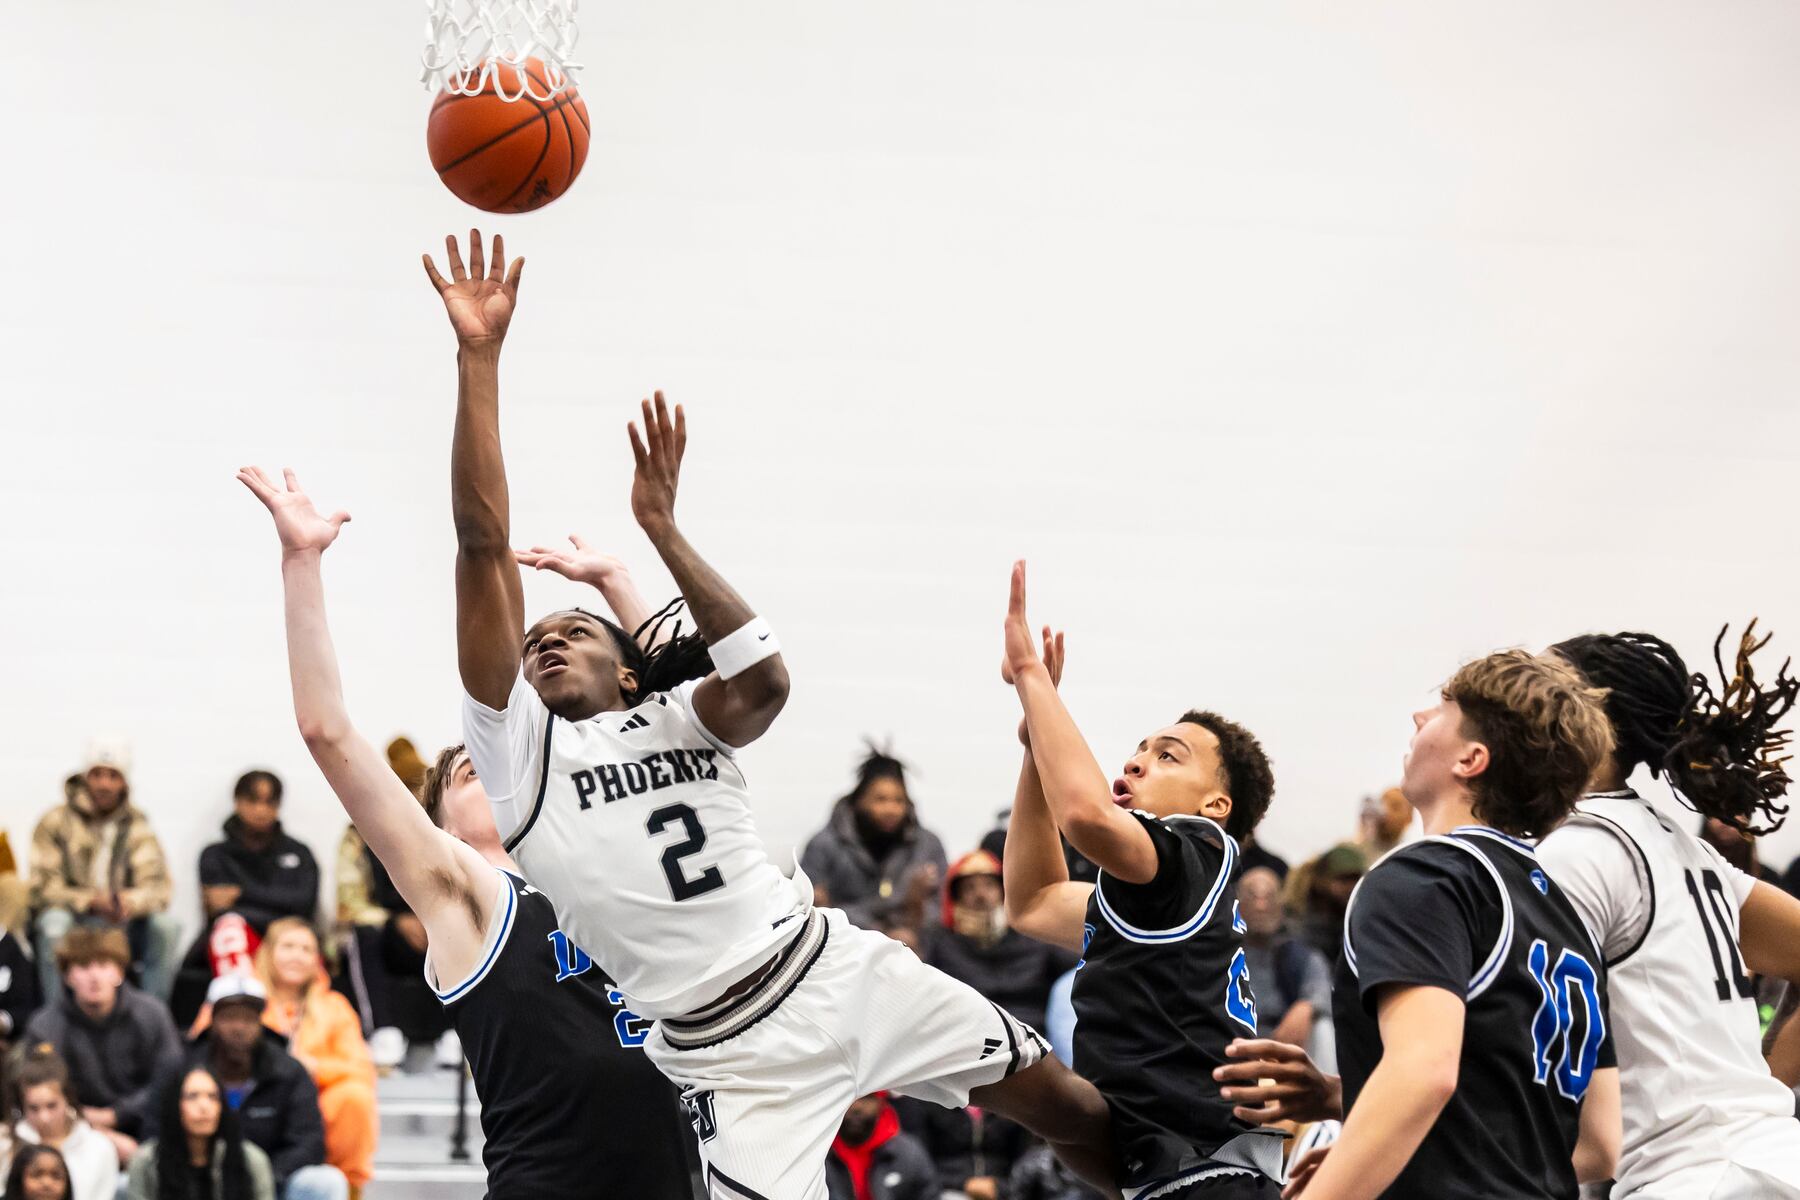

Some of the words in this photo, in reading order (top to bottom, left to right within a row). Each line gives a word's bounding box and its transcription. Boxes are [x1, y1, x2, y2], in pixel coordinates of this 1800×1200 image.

[570, 748, 719, 811] PHOENIX
[643, 800, 727, 902] 2
[1527, 938, 1606, 1103] 10
